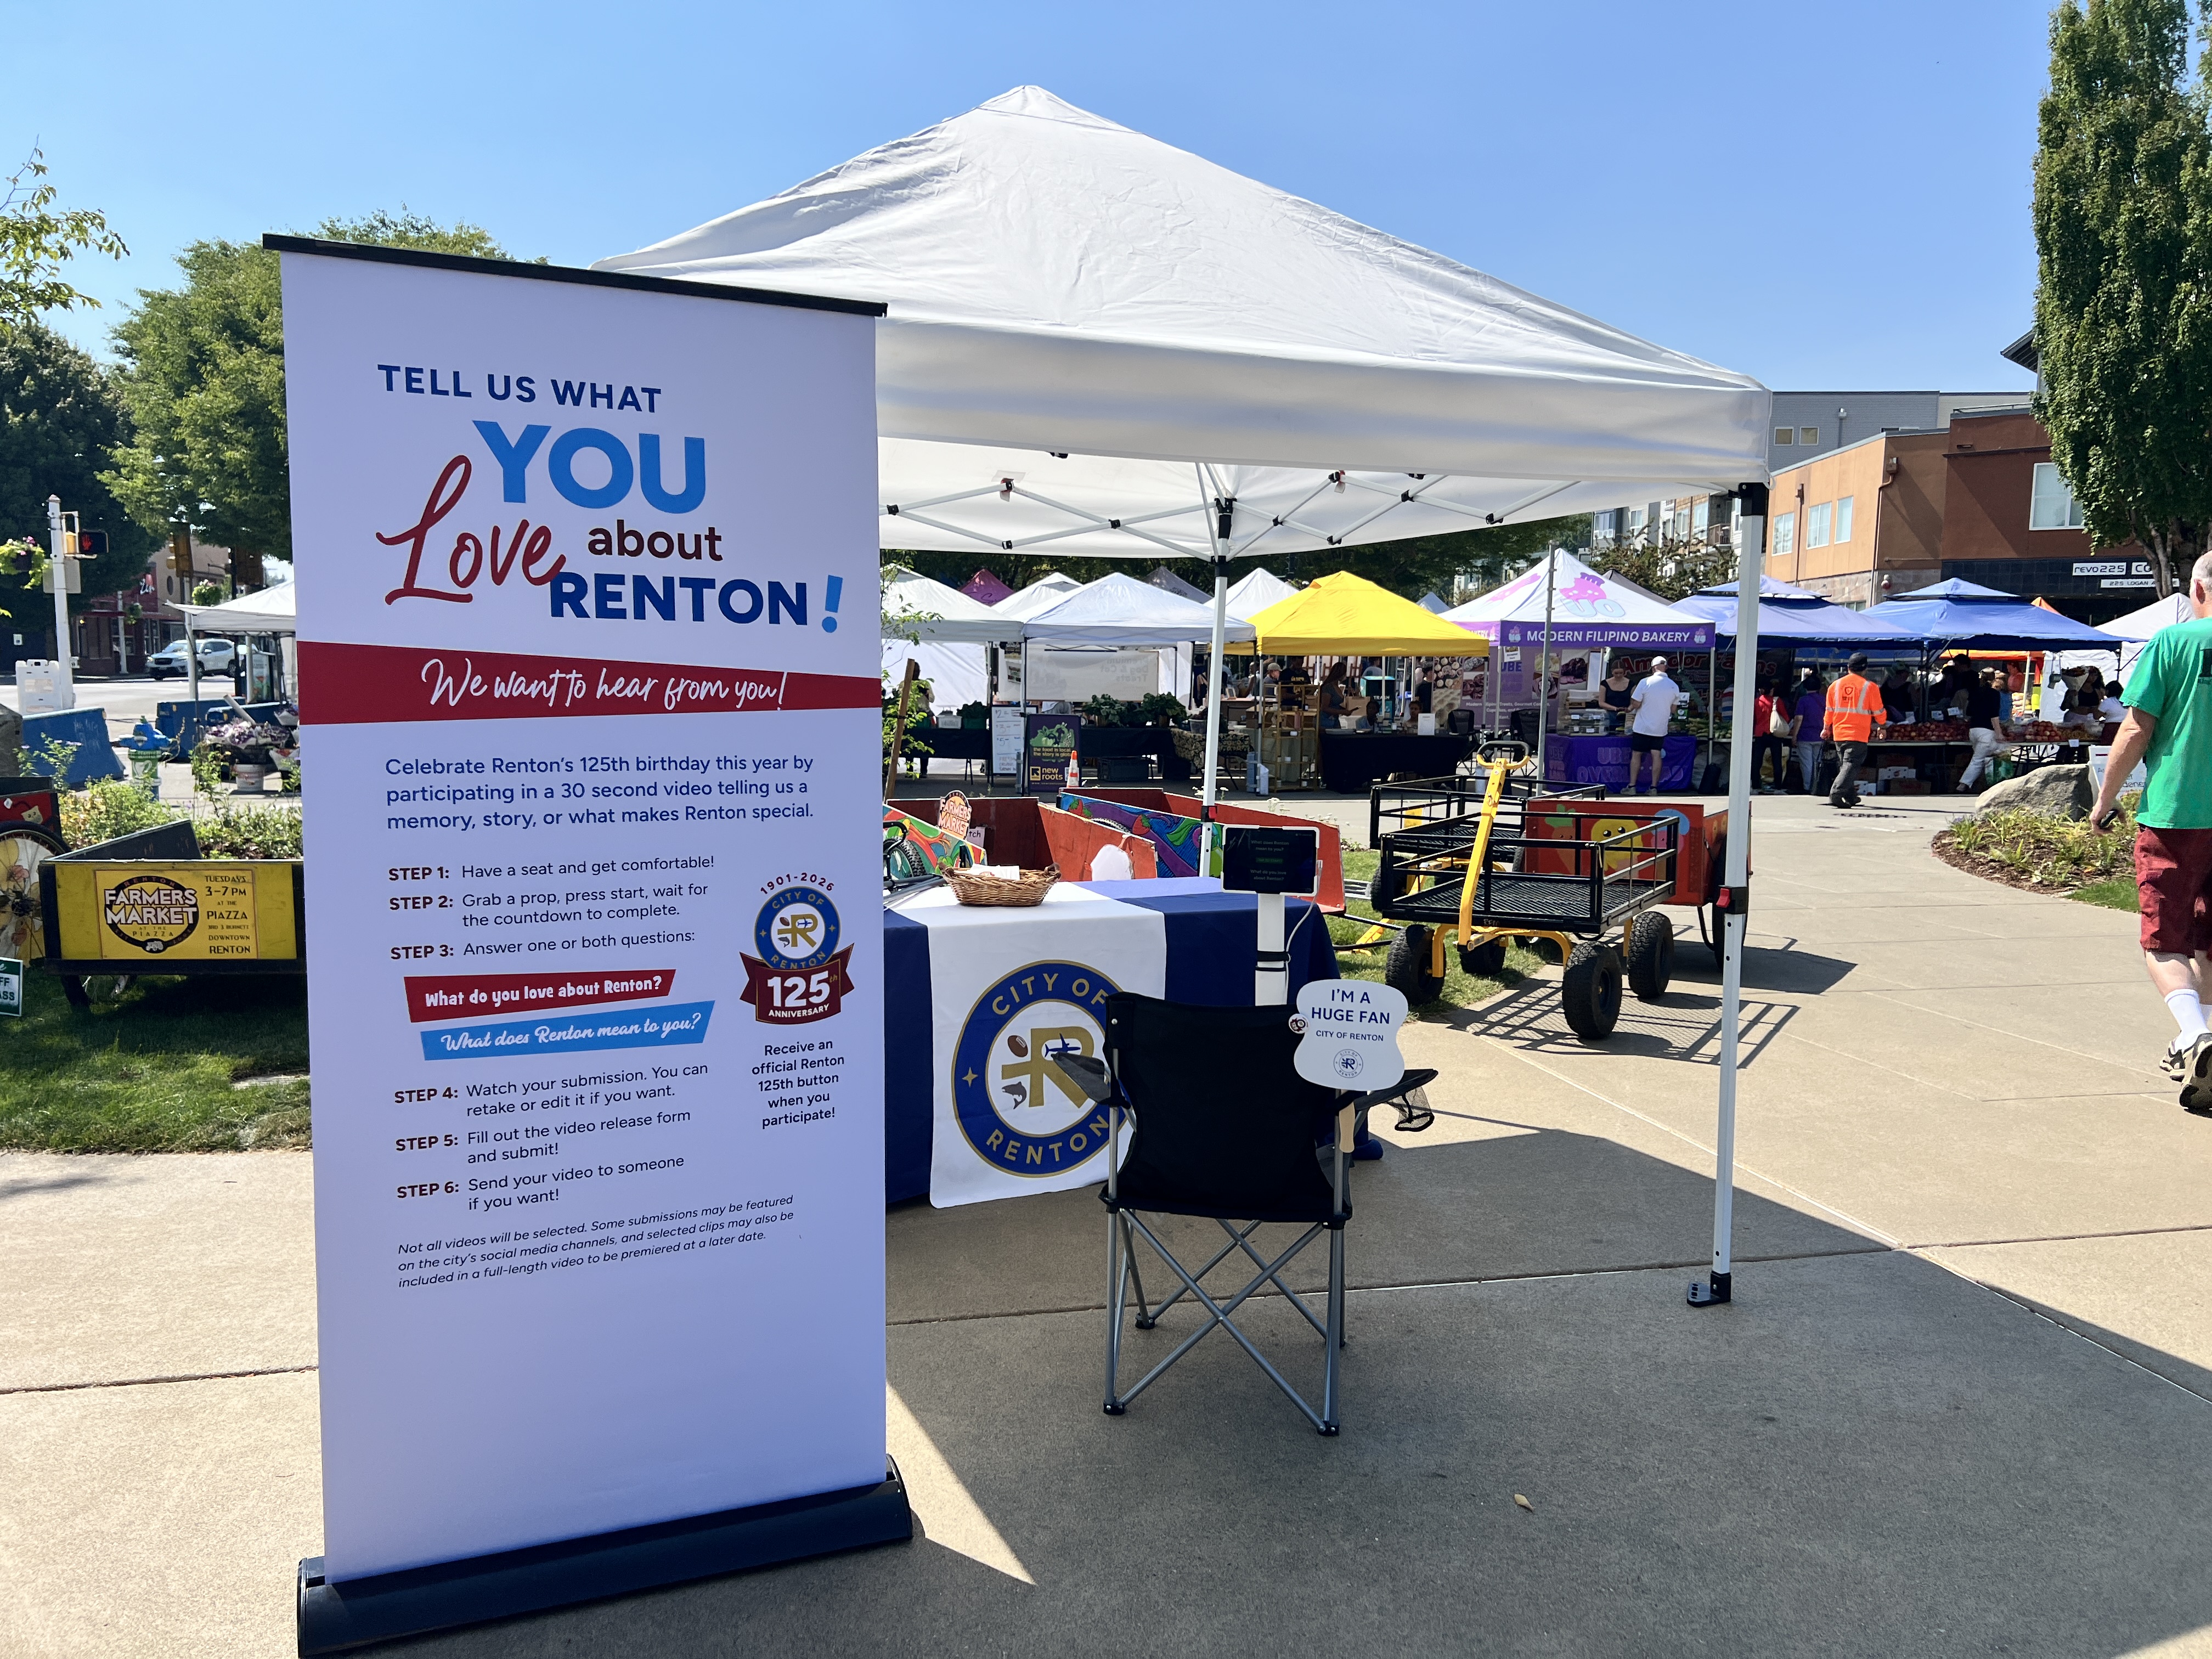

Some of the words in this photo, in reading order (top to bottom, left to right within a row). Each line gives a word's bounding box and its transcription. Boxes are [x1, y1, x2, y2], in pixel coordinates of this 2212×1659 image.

[377, 364, 472, 398] TELL
[487, 373, 536, 403] US
[550, 379, 662, 414] WHAT
[472, 420, 706, 514] YOU
[375, 455, 566, 606] Love
[588, 520, 723, 561] about
[1586, 631, 1639, 642] FILIPINO
[1642, 631, 1690, 642] BAKERY
[1621, 653, 1707, 675] Amdor
[421, 658, 488, 707] We
[494, 669, 567, 707] want
[564, 669, 586, 707] to
[596, 668, 659, 702] hear
[664, 678, 730, 710] from
[735, 670, 788, 711] you!
[385, 758, 485, 775] Celebrate
[492, 757, 574, 773] Renton's
[580, 756, 630, 772] 125th
[636, 755, 710, 775] birthday
[715, 755, 747, 770] this
[752, 758, 789, 774] year
[793, 754, 814, 773] by
[940, 799, 972, 821] FARMERS
[938, 812, 969, 837] MARKET
[388, 867, 432, 881] STEP
[437, 866, 449, 879] 1:
[462, 865, 503, 878] Have
[507, 866, 516, 876] a
[521, 862, 554, 876] seat
[558, 860, 586, 874] and
[591, 860, 617, 876] get
[621, 855, 714, 871] comfortable!
[232, 888, 247, 896] PM
[760, 872, 834, 895] 1901-2026
[104, 888, 198, 905] FARMERS
[771, 891, 802, 910] CITY
[807, 894, 825, 906] OF
[105, 906, 198, 924] MARKET
[207, 910, 248, 920] PIAZZA
[210, 945, 251, 955] RENTON
[391, 945, 435, 960] STEP
[439, 944, 454, 957] 3:
[463, 943, 523, 956] Answer
[527, 941, 557, 952] one
[561, 939, 577, 950] or
[582, 934, 616, 949] both
[621, 930, 695, 949] questions:
[770, 950, 827, 969] RENTON
[425, 990, 464, 1007] What
[469, 989, 488, 1005] do
[492, 990, 520, 1008] you
[524, 985, 554, 1000] love
[558, 982, 600, 998] about
[604, 975, 662, 994] Renton?
[992, 973, 1059, 1015] CITY
[1072, 978, 1109, 1006] OF
[1331, 988, 1355, 1003] I'M
[1359, 991, 1370, 1004] A
[768, 1003, 830, 1018] ANNIVERSARY
[1311, 1007, 1354, 1022] HUGE
[1359, 1010, 1390, 1025] FAN
[440, 1031, 492, 1051] What
[494, 1030, 530, 1047] does
[534, 1025, 595, 1045] Renton
[597, 1024, 642, 1037] mean
[644, 1017, 660, 1034] to
[660, 1012, 702, 1039] you?
[1316, 1030, 1334, 1038] CITY
[1350, 1032, 1384, 1042] RENTON
[764, 1041, 815, 1056] Receive
[818, 1041, 833, 1050] an
[751, 1059, 797, 1075] official
[801, 1056, 845, 1070] Renton
[758, 1077, 793, 1092] 125th
[797, 1074, 839, 1087] button
[768, 1096, 803, 1108] when
[806, 1093, 830, 1107] you
[762, 1107, 835, 1130] participate!
[986, 1114, 1109, 1165] RENTON
[398, 1243, 424, 1255] Not
[426, 1240, 442, 1251] all
[445, 1237, 487, 1249] videos
[490, 1232, 511, 1244] will
[514, 1231, 529, 1242] be
[532, 1222, 587, 1239] selected.
[590, 1220, 625, 1231] Some
[628, 1210, 698, 1226] submissions
[701, 1206, 726, 1217] may
[729, 1203, 743, 1213] be
[746, 1194, 793, 1210] featured
